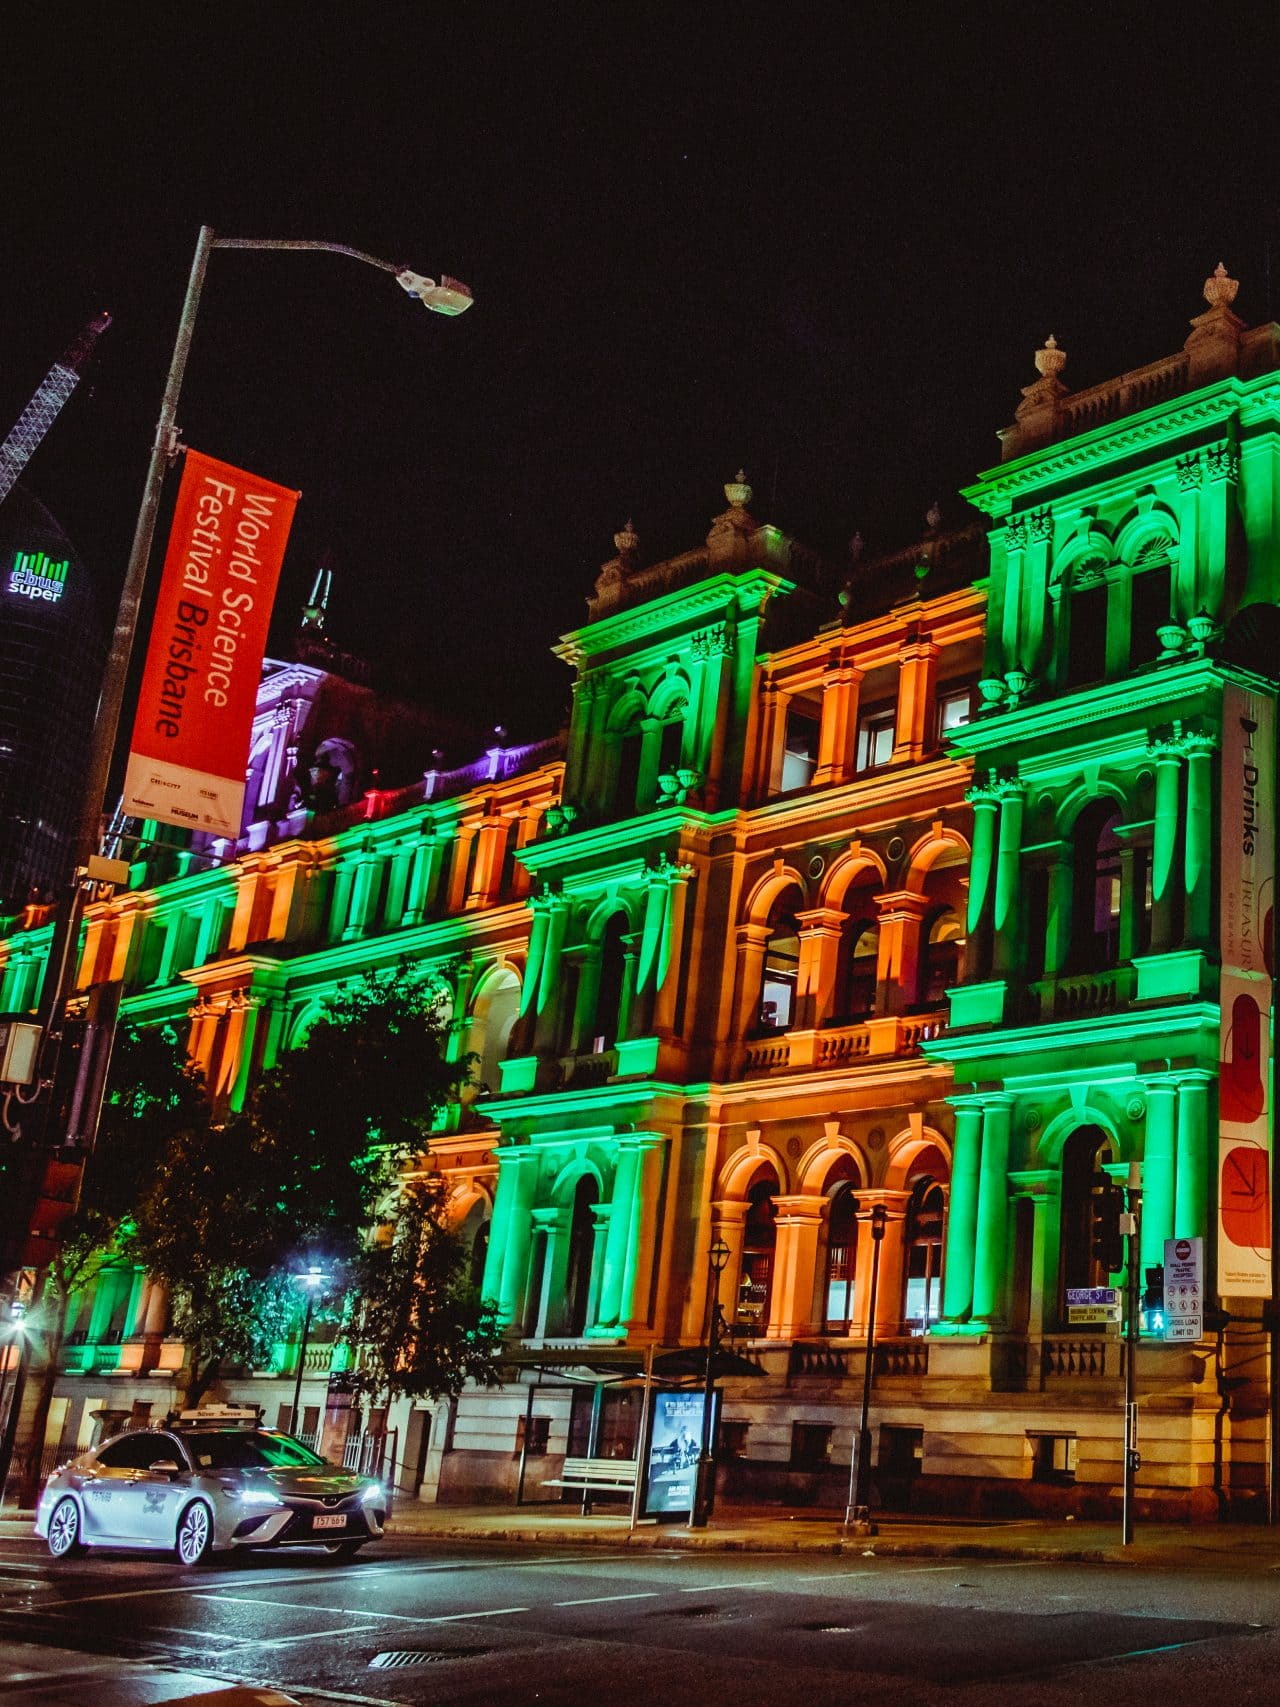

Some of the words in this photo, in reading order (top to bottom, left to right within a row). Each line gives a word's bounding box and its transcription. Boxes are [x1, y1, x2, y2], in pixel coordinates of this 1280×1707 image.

[11, 568, 64, 593] cbus
[182, 476, 236, 597] Festival
[231, 492, 277, 585] World
[8, 582, 62, 602] super
[155, 600, 209, 738] Brisbane
[204, 587, 254, 708] Science
[1243, 765, 1259, 857] Drinks
[1241, 879, 1254, 979] TREASURY
[1067, 1289, 1093, 1300] GEORGE
